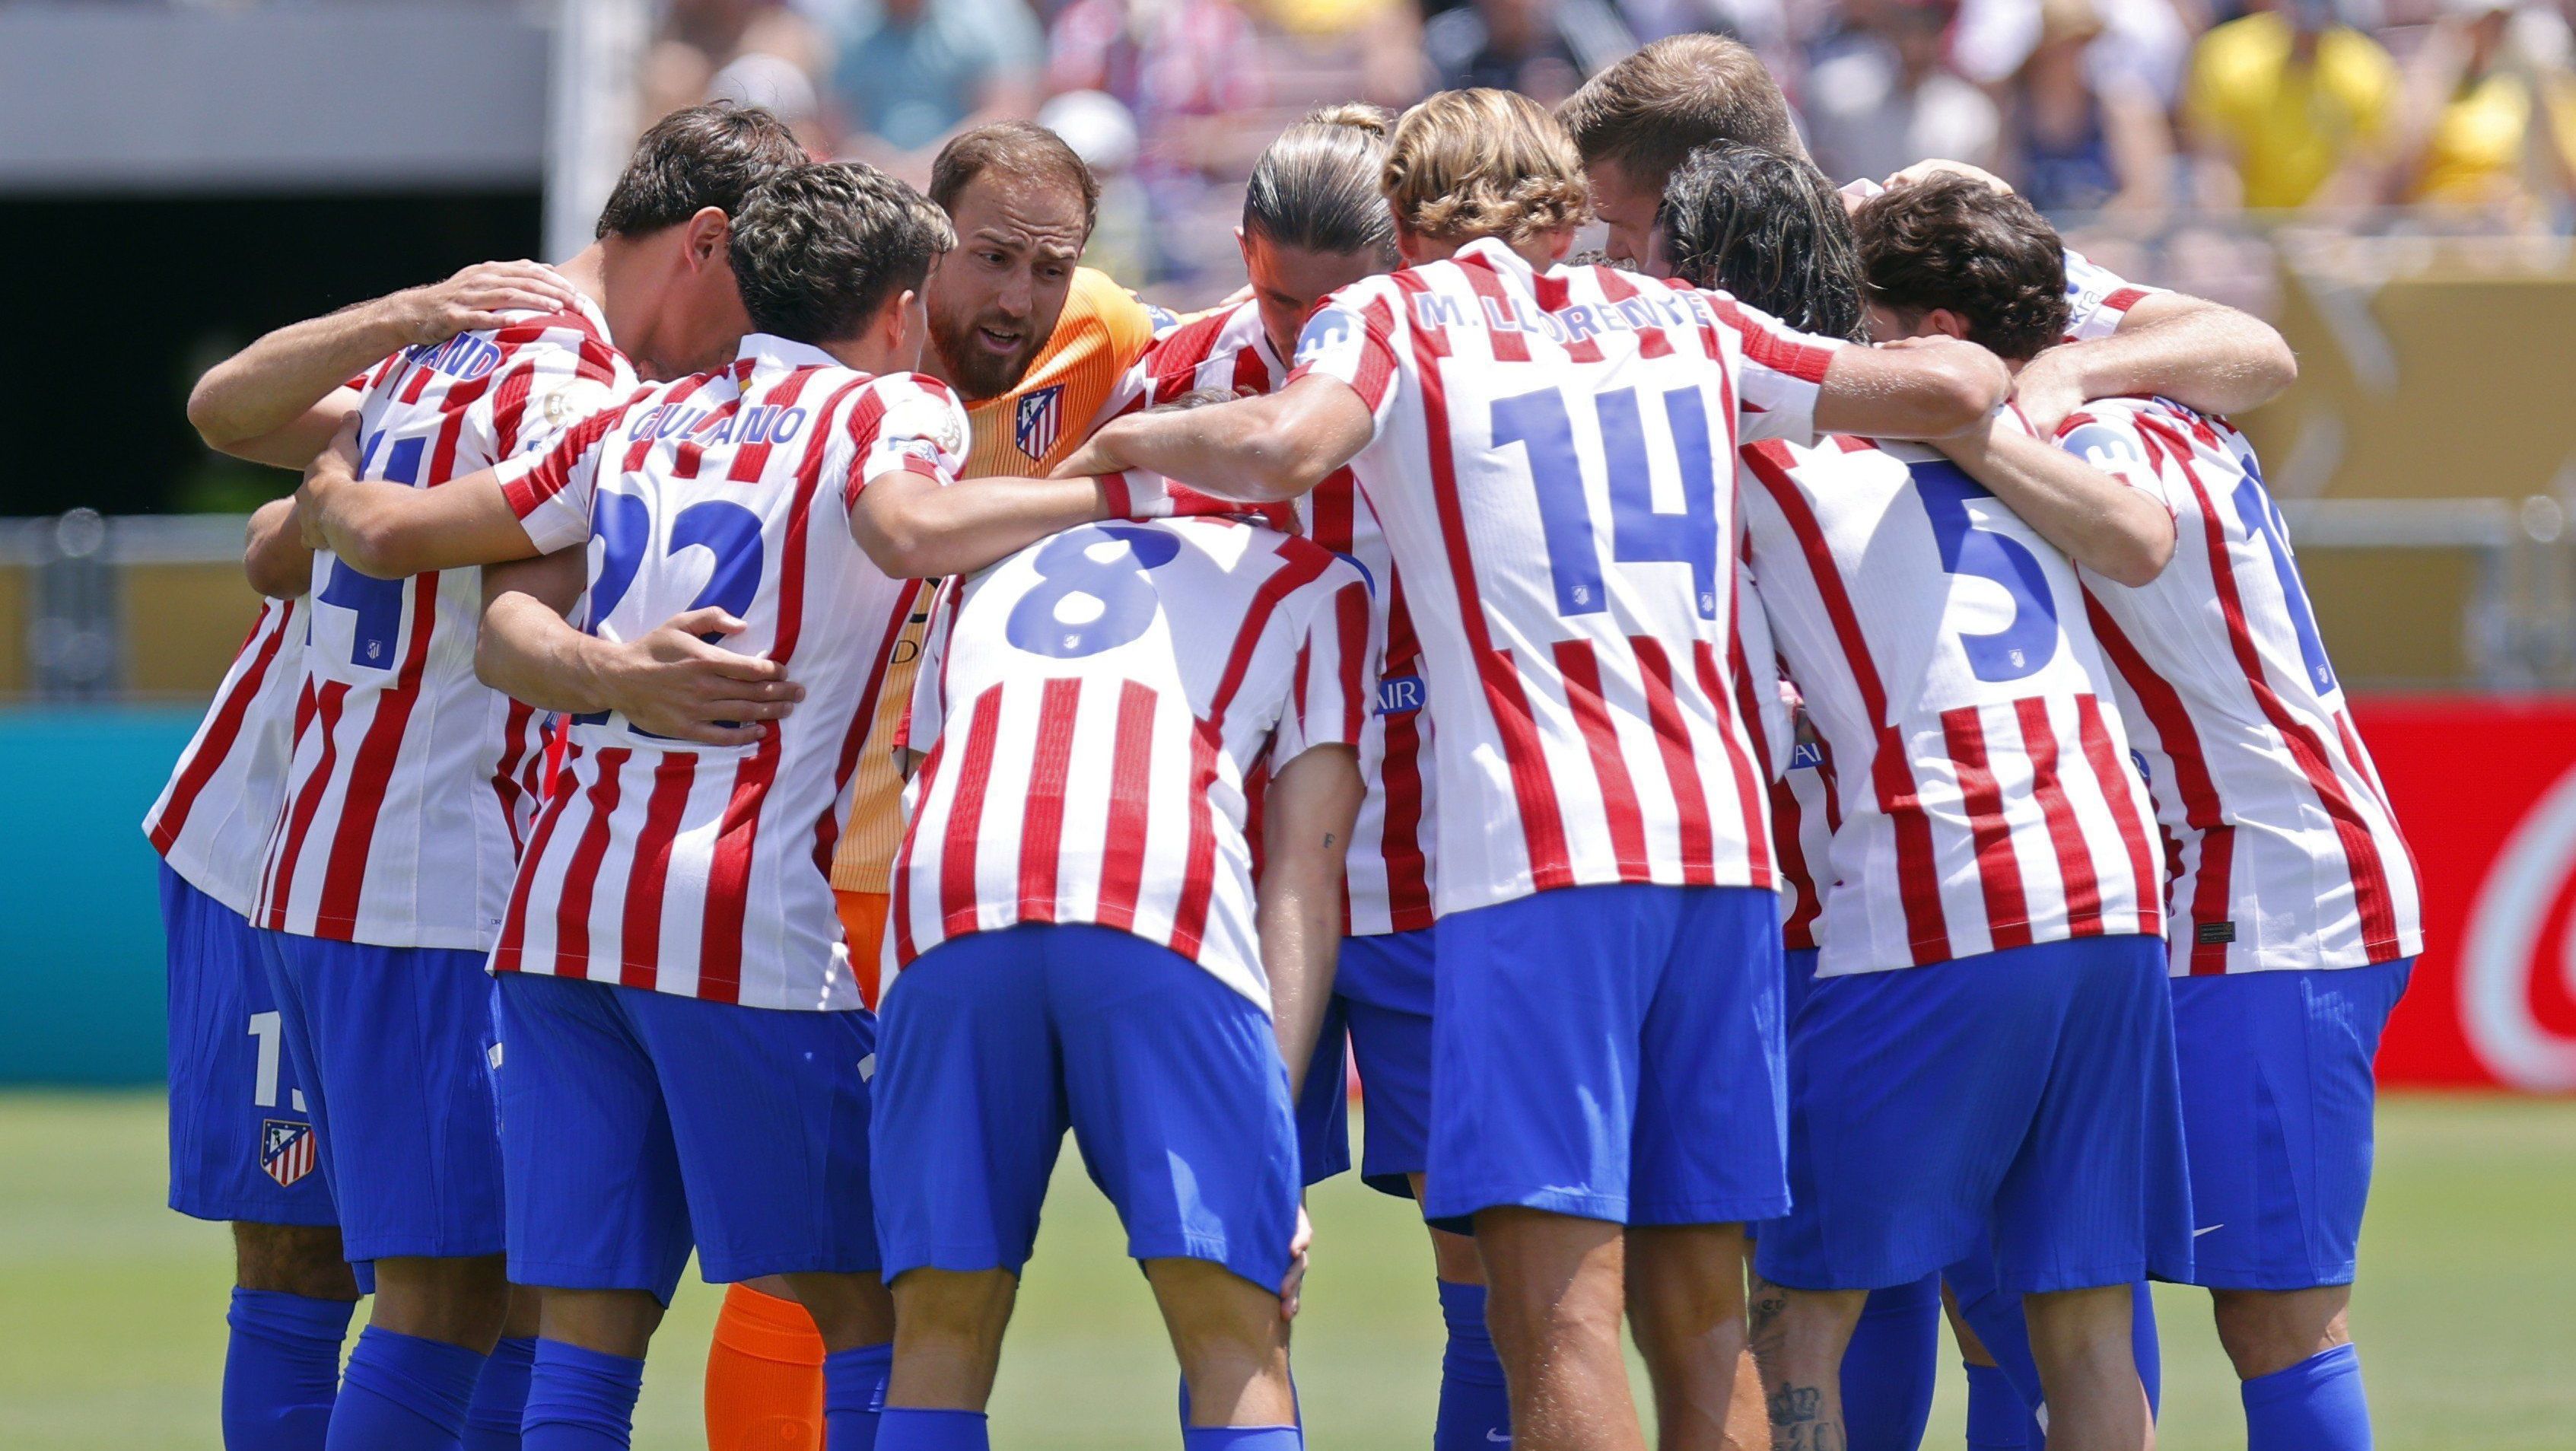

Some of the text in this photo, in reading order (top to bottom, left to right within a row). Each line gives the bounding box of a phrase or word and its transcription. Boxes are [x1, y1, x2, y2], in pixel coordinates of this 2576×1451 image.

[1480, 288, 1709, 345] LLORENTE
[305, 415, 427, 670] 4
[1005, 526, 1181, 660] 8
[1490, 384, 1718, 621] 14
[1907, 460, 2059, 683] 5
[2231, 453, 2337, 697] 1
[1795, 743, 1823, 765] AI
